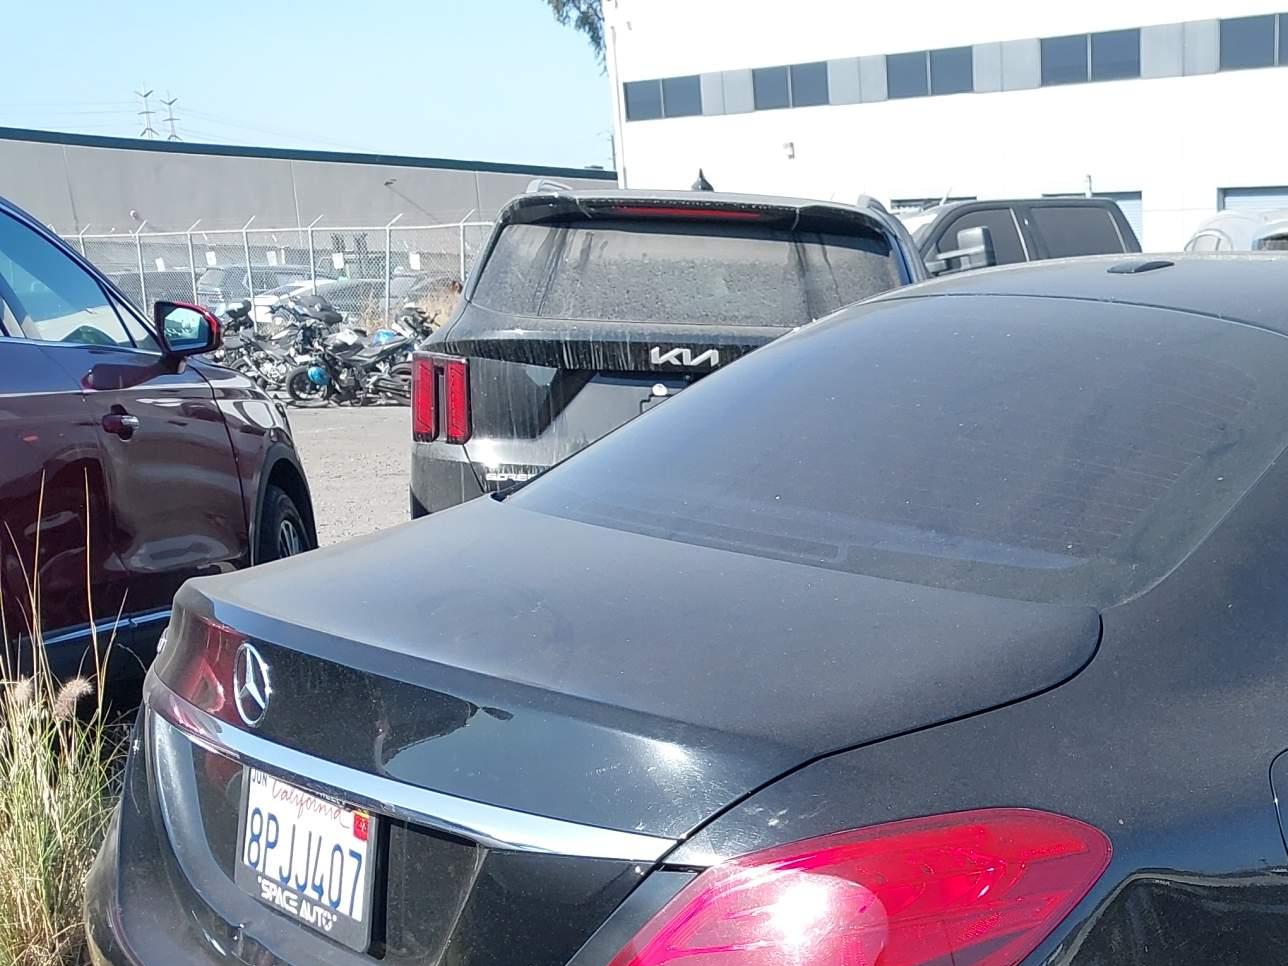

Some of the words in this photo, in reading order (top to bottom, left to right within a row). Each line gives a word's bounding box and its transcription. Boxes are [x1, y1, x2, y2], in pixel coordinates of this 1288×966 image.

[650, 346, 719, 367] KIA
[250, 768, 268, 786] JUN
[271, 778, 350, 829] California
[247, 807, 363, 918] 8PJJ407
[260, 880, 300, 916] SPACE
[300, 899, 333, 932] AUTO
